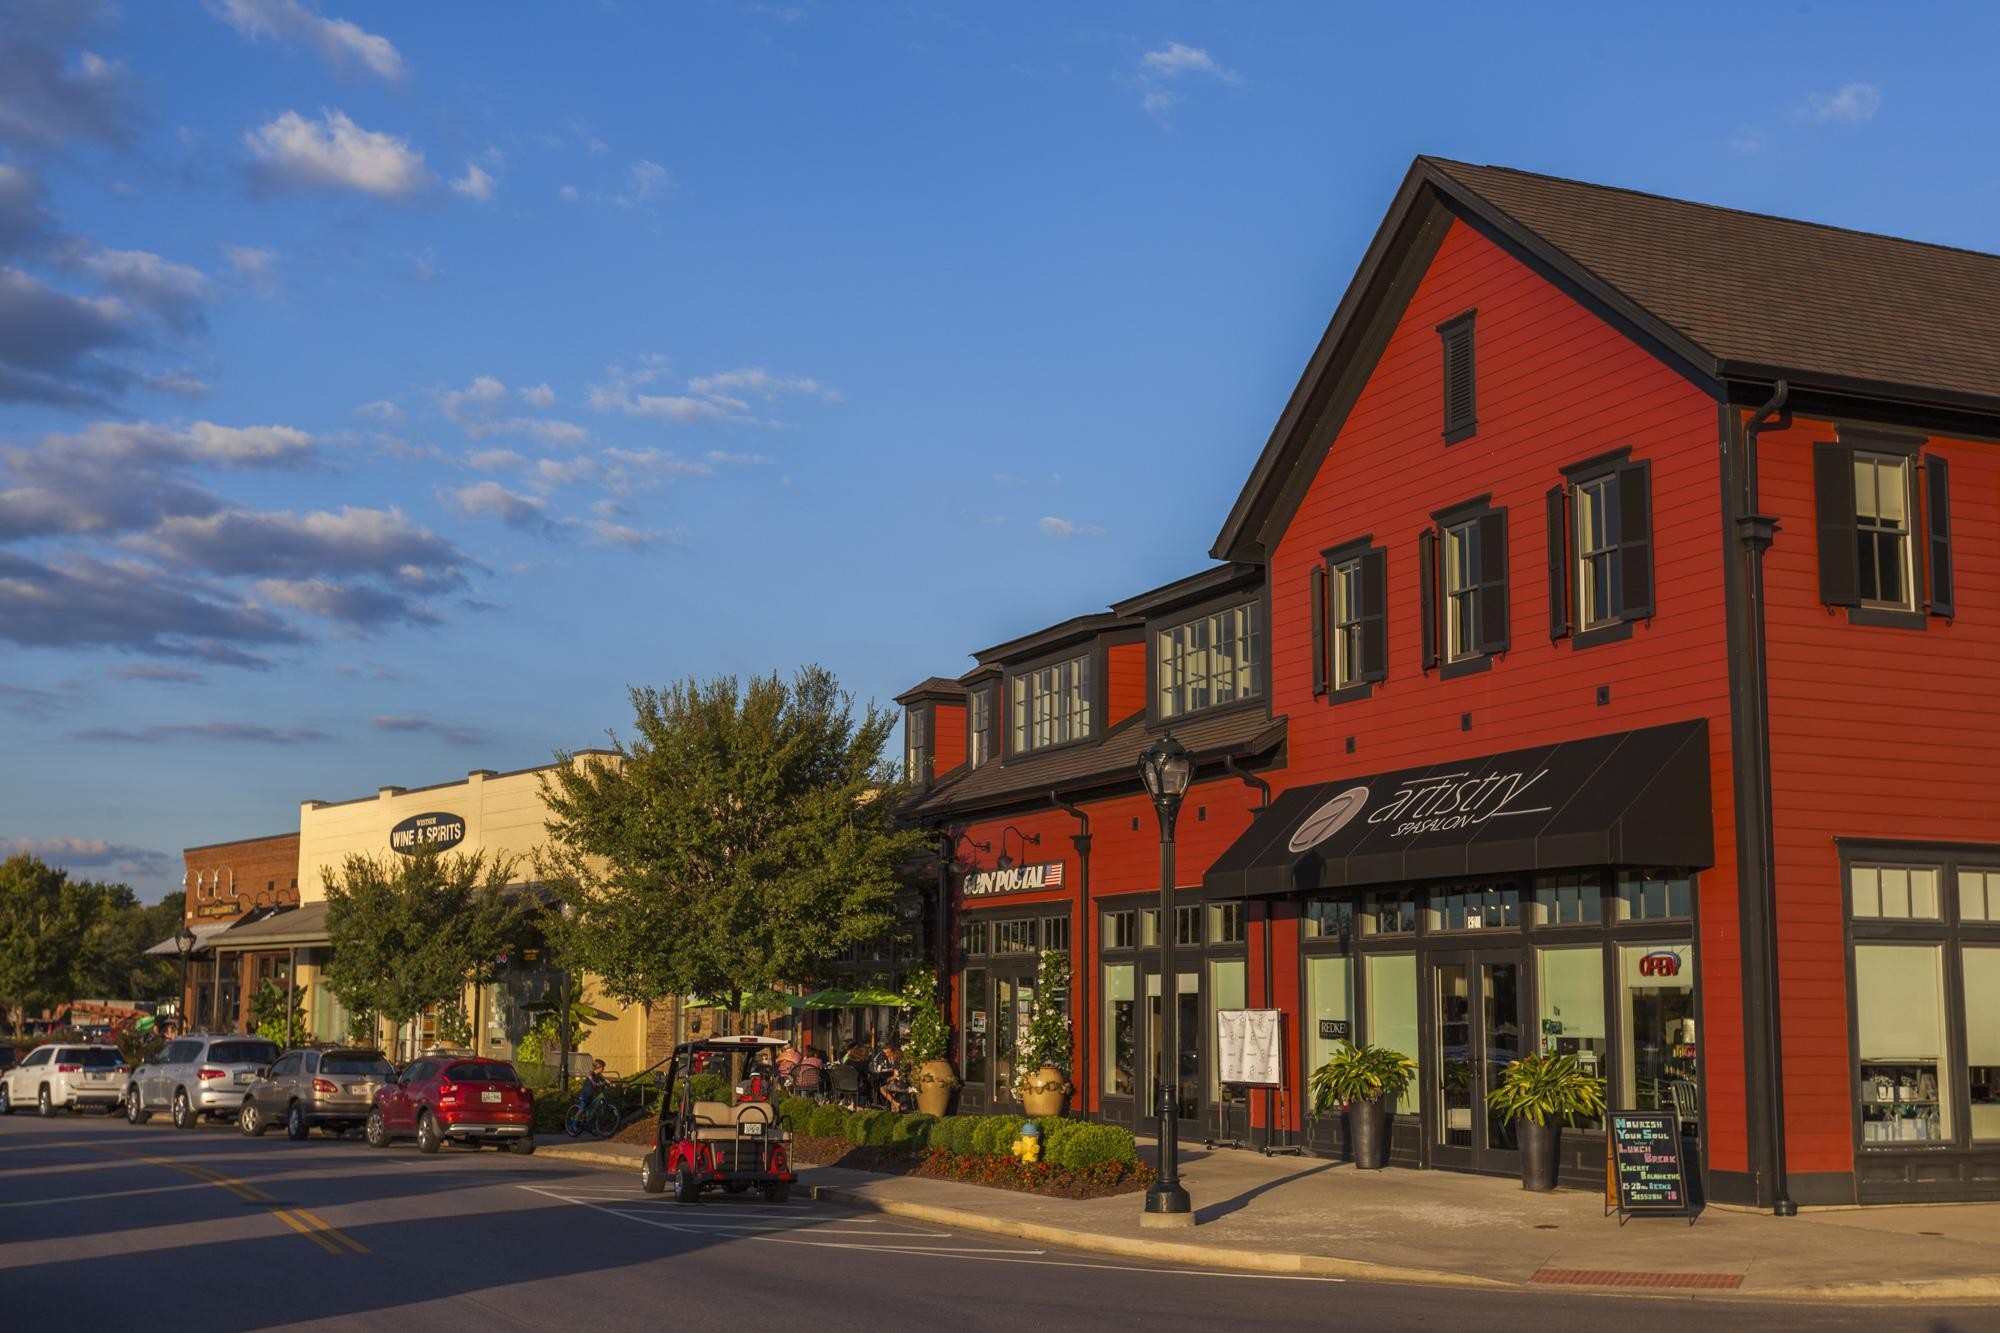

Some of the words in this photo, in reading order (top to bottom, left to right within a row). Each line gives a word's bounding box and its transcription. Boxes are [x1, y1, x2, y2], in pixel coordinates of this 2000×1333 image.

[1368, 769, 1552, 824] artistry
[393, 829, 415, 848] WINE
[417, 828, 424, 844] &
[426, 823, 461, 842] SPIRITS
[1390, 815, 1474, 837] SPASALON
[995, 865, 1046, 892] POSTAL
[1639, 955, 1680, 977] OPEN
